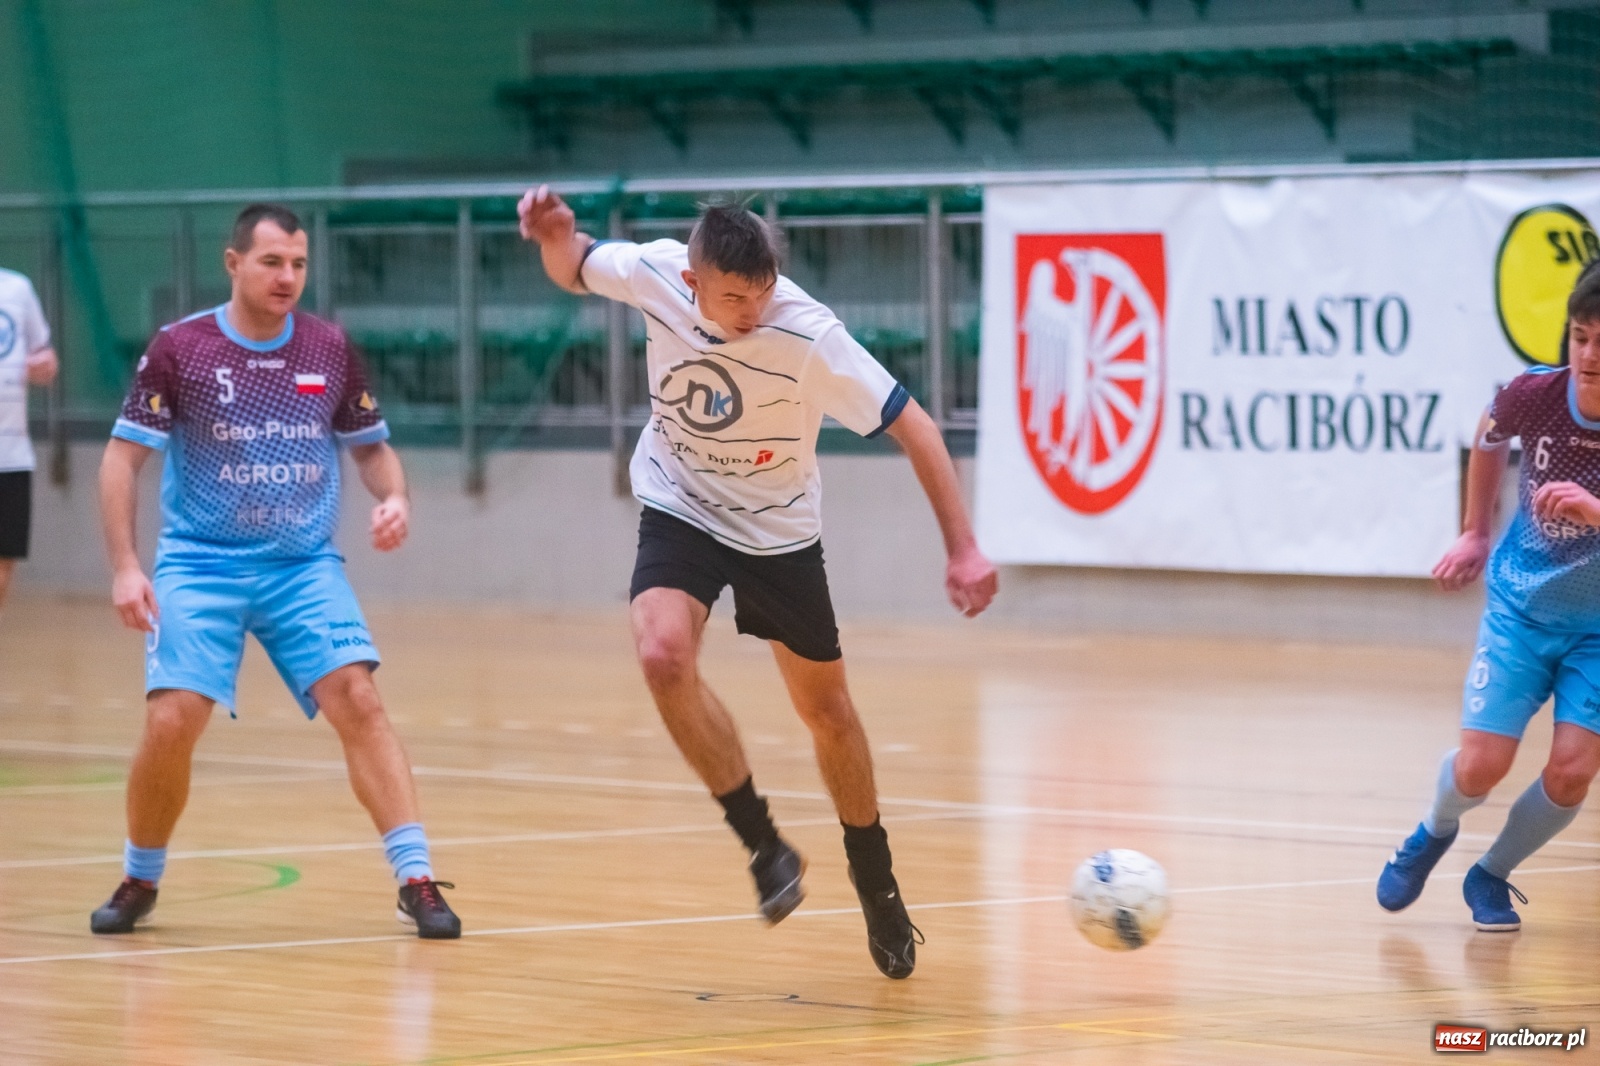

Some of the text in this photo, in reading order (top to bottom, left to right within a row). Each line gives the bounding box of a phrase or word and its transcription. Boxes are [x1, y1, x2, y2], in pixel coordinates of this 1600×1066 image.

[1211, 293, 1411, 356] MIASTO
[215, 367, 235, 404] 5
[1180, 372, 1444, 452] RACIBÓRZ
[1535, 435, 1553, 470] 6
